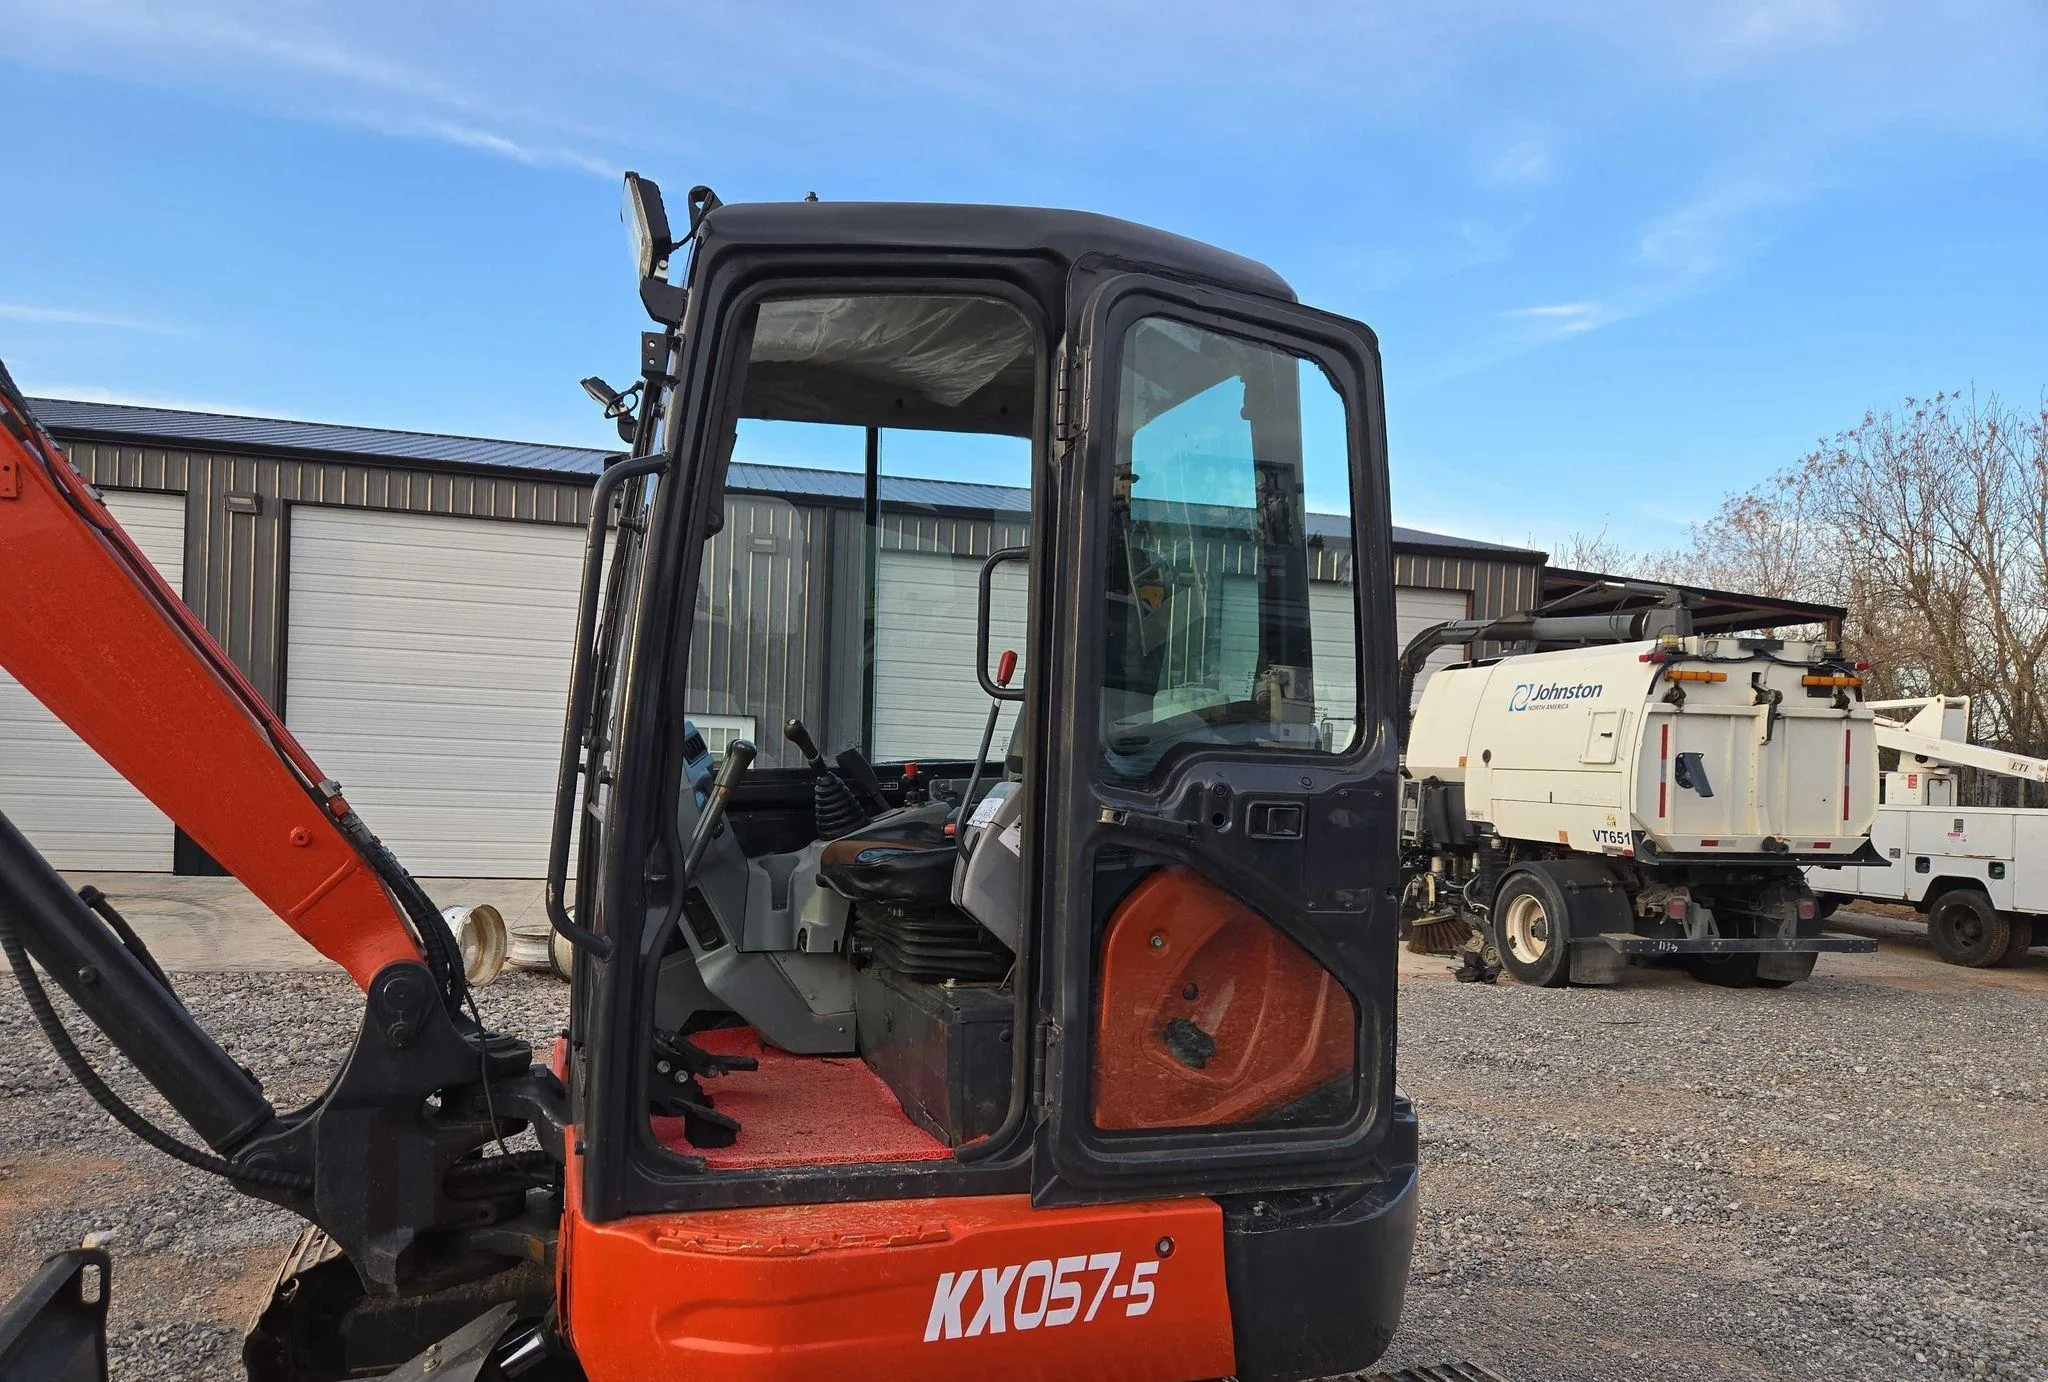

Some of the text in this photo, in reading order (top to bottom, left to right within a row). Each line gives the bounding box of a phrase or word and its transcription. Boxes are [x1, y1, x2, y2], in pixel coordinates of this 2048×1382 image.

[1531, 682, 1603, 702] Johnston
[1528, 702, 1569, 711] NORTH AMERICA
[2010, 761, 2029, 773] ETI
[1592, 829, 1631, 845] VT651
[923, 1251, 1160, 1343] KX057-5
